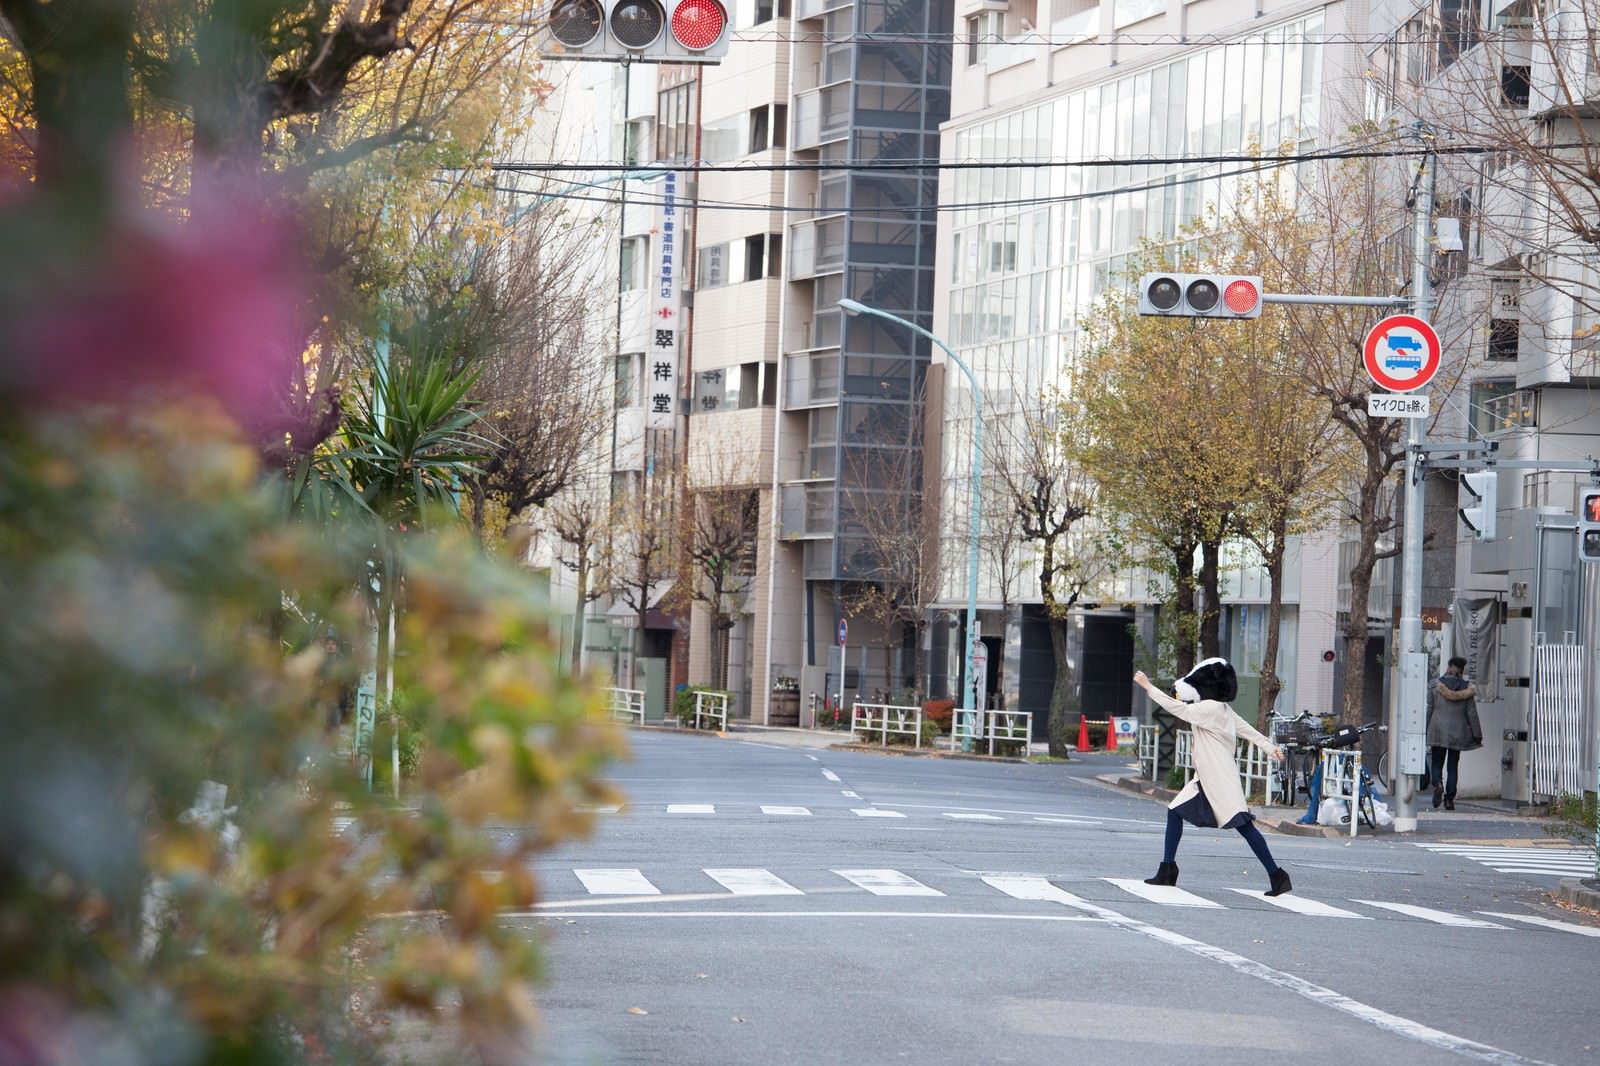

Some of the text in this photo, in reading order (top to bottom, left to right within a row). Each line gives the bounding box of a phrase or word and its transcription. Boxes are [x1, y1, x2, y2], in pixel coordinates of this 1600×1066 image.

[652, 329, 674, 414] 翠祥堂
[1372, 399, 1425, 413] マイクロを除く
